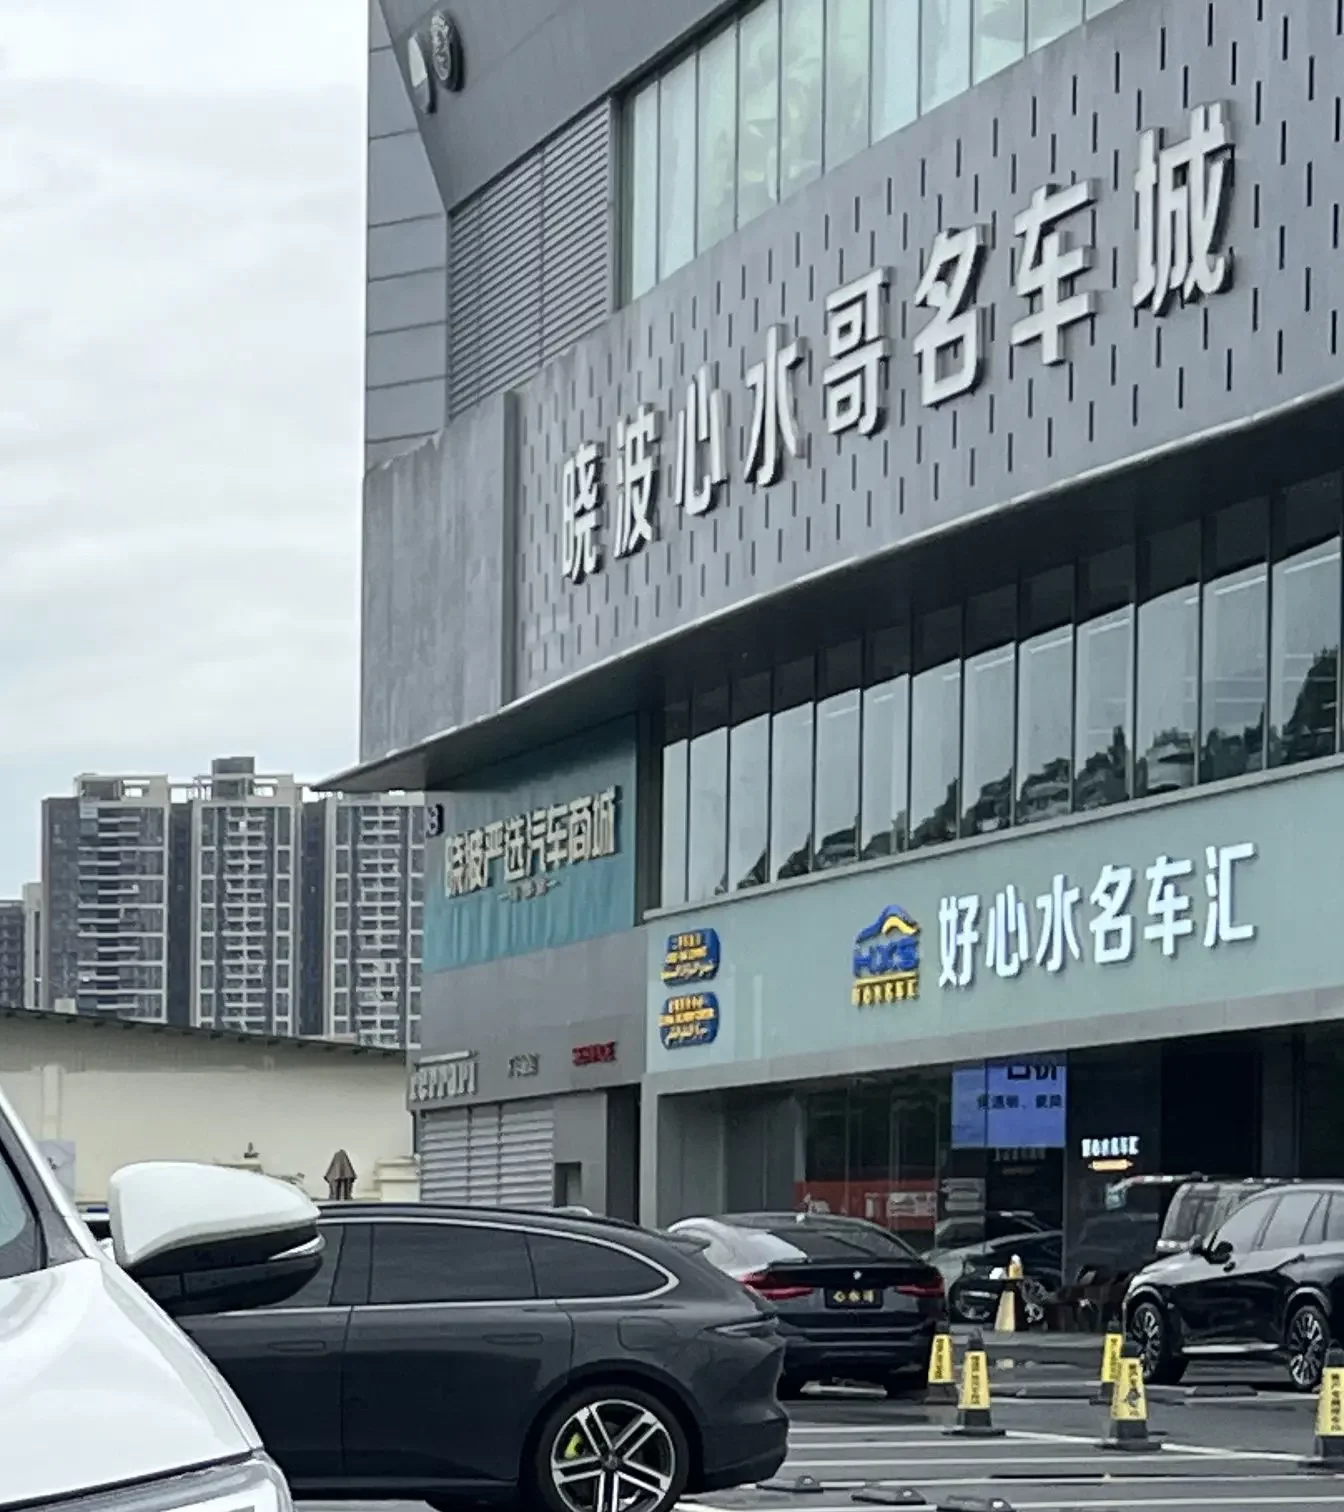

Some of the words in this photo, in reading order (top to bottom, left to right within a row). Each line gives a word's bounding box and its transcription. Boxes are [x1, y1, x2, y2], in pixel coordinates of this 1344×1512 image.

[561, 100, 1234, 583] 晓波心水哥名车城
[445, 784, 617, 900] 晓波严选汽车商城
[939, 842, 1255, 988] 好心水名车汇
